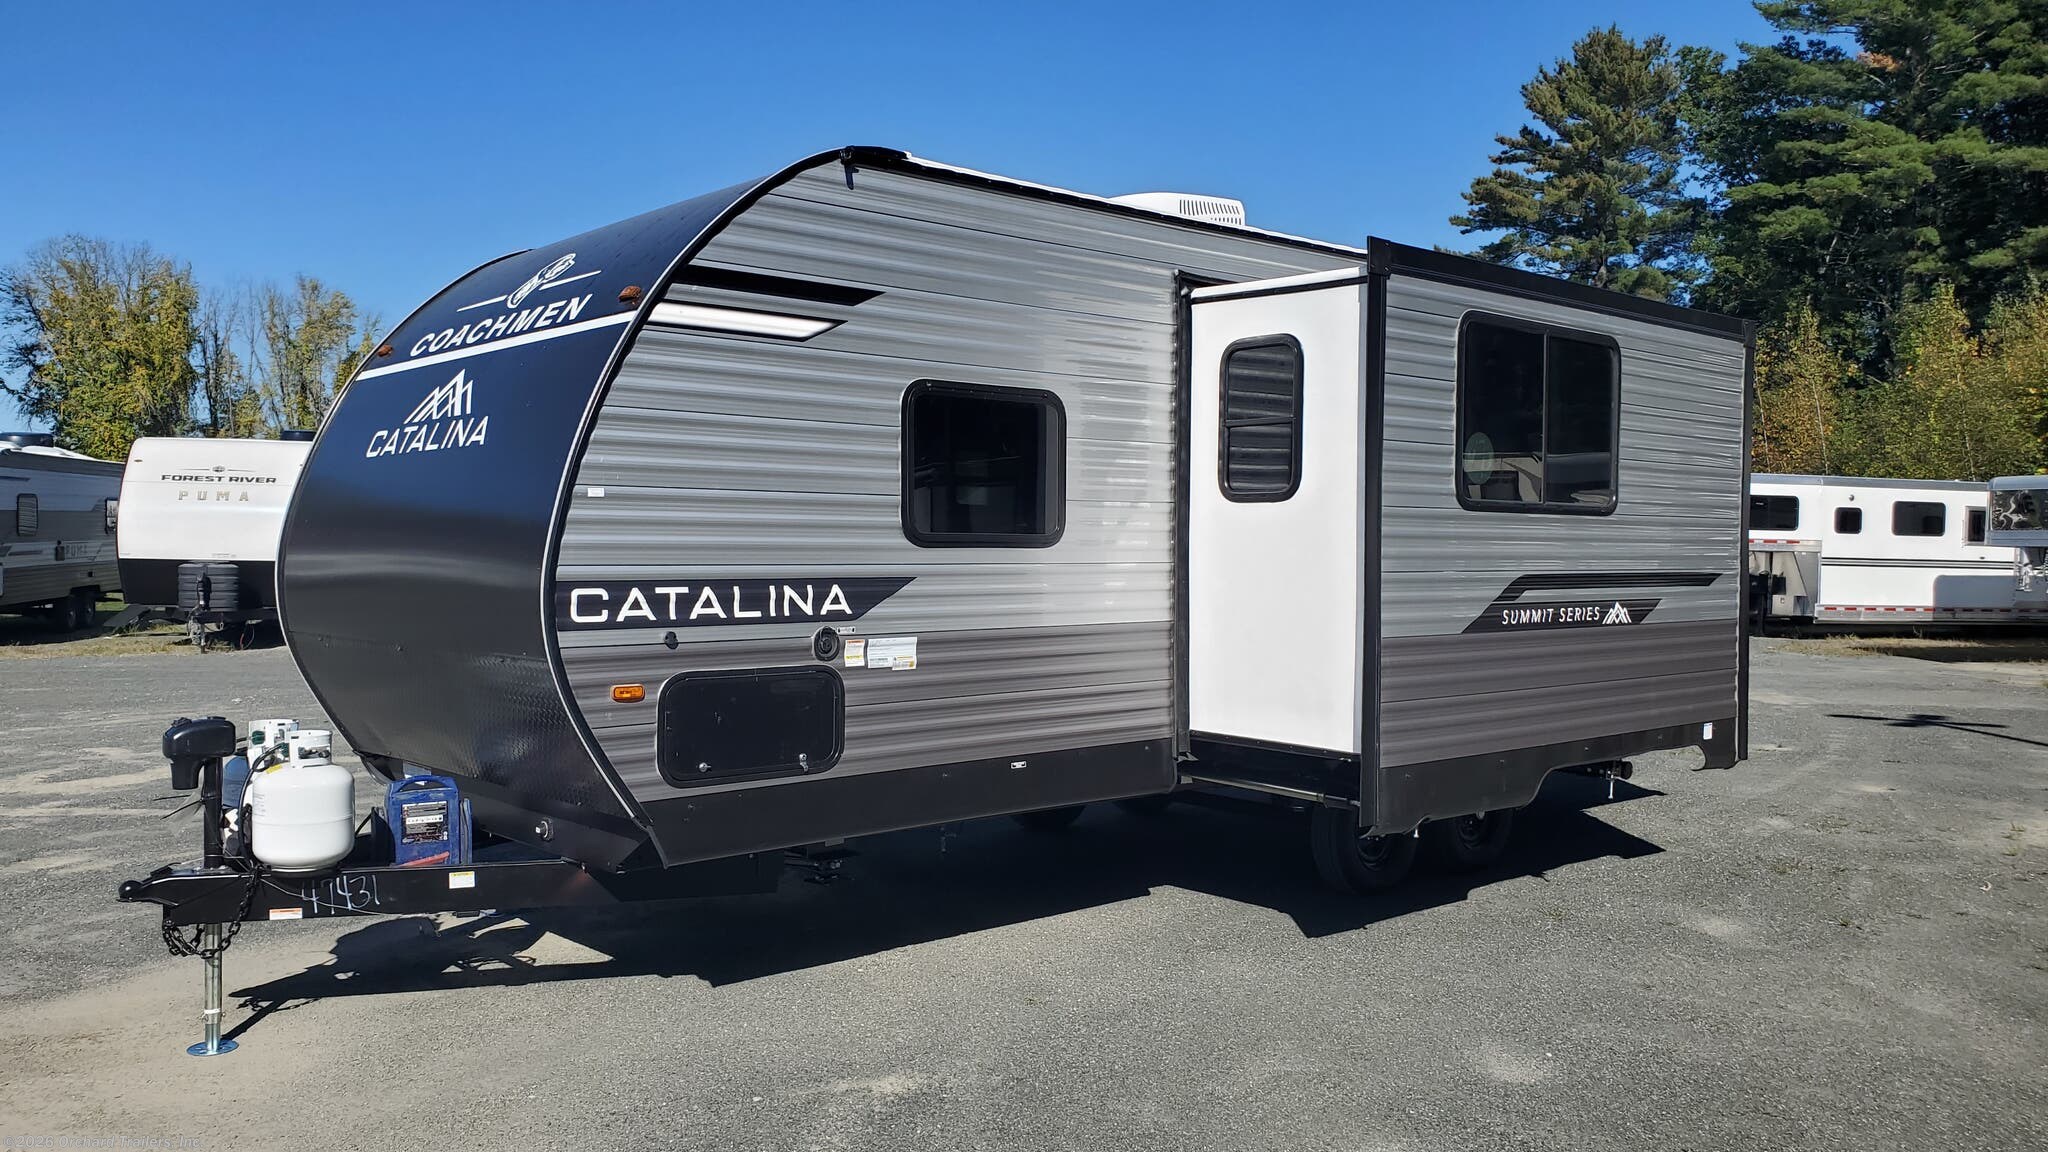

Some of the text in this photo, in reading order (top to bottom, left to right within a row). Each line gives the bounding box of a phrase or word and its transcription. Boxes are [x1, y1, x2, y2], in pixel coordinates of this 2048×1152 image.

[409, 293, 593, 357] COACHMEN
[365, 415, 489, 458] CATALINA
[161, 474, 225, 482] FOREST
[178, 490, 249, 502] PUMA
[569, 584, 853, 624] CATALINA
[1501, 606, 1600, 625] SUMMIT SERIES
[301, 874, 380, 915] 47431
